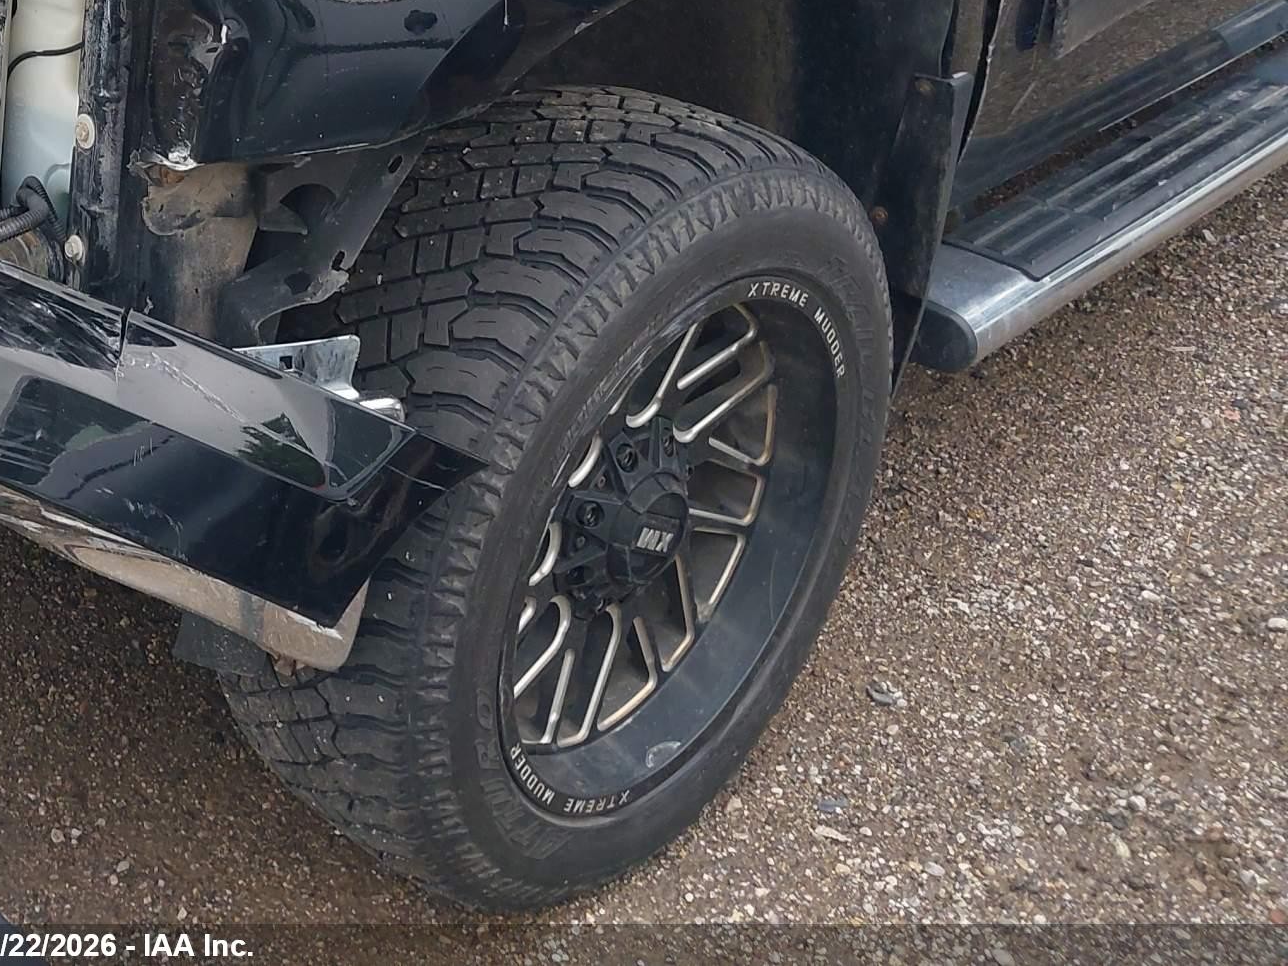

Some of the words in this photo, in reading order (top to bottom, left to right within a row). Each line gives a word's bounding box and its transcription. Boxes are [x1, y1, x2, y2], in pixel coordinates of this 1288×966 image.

[747, 282, 809, 308] XTREME
[813, 307, 846, 378] MUDDER
[509, 742, 556, 806] MUDDER
[563, 789, 631, 814] XTREME
